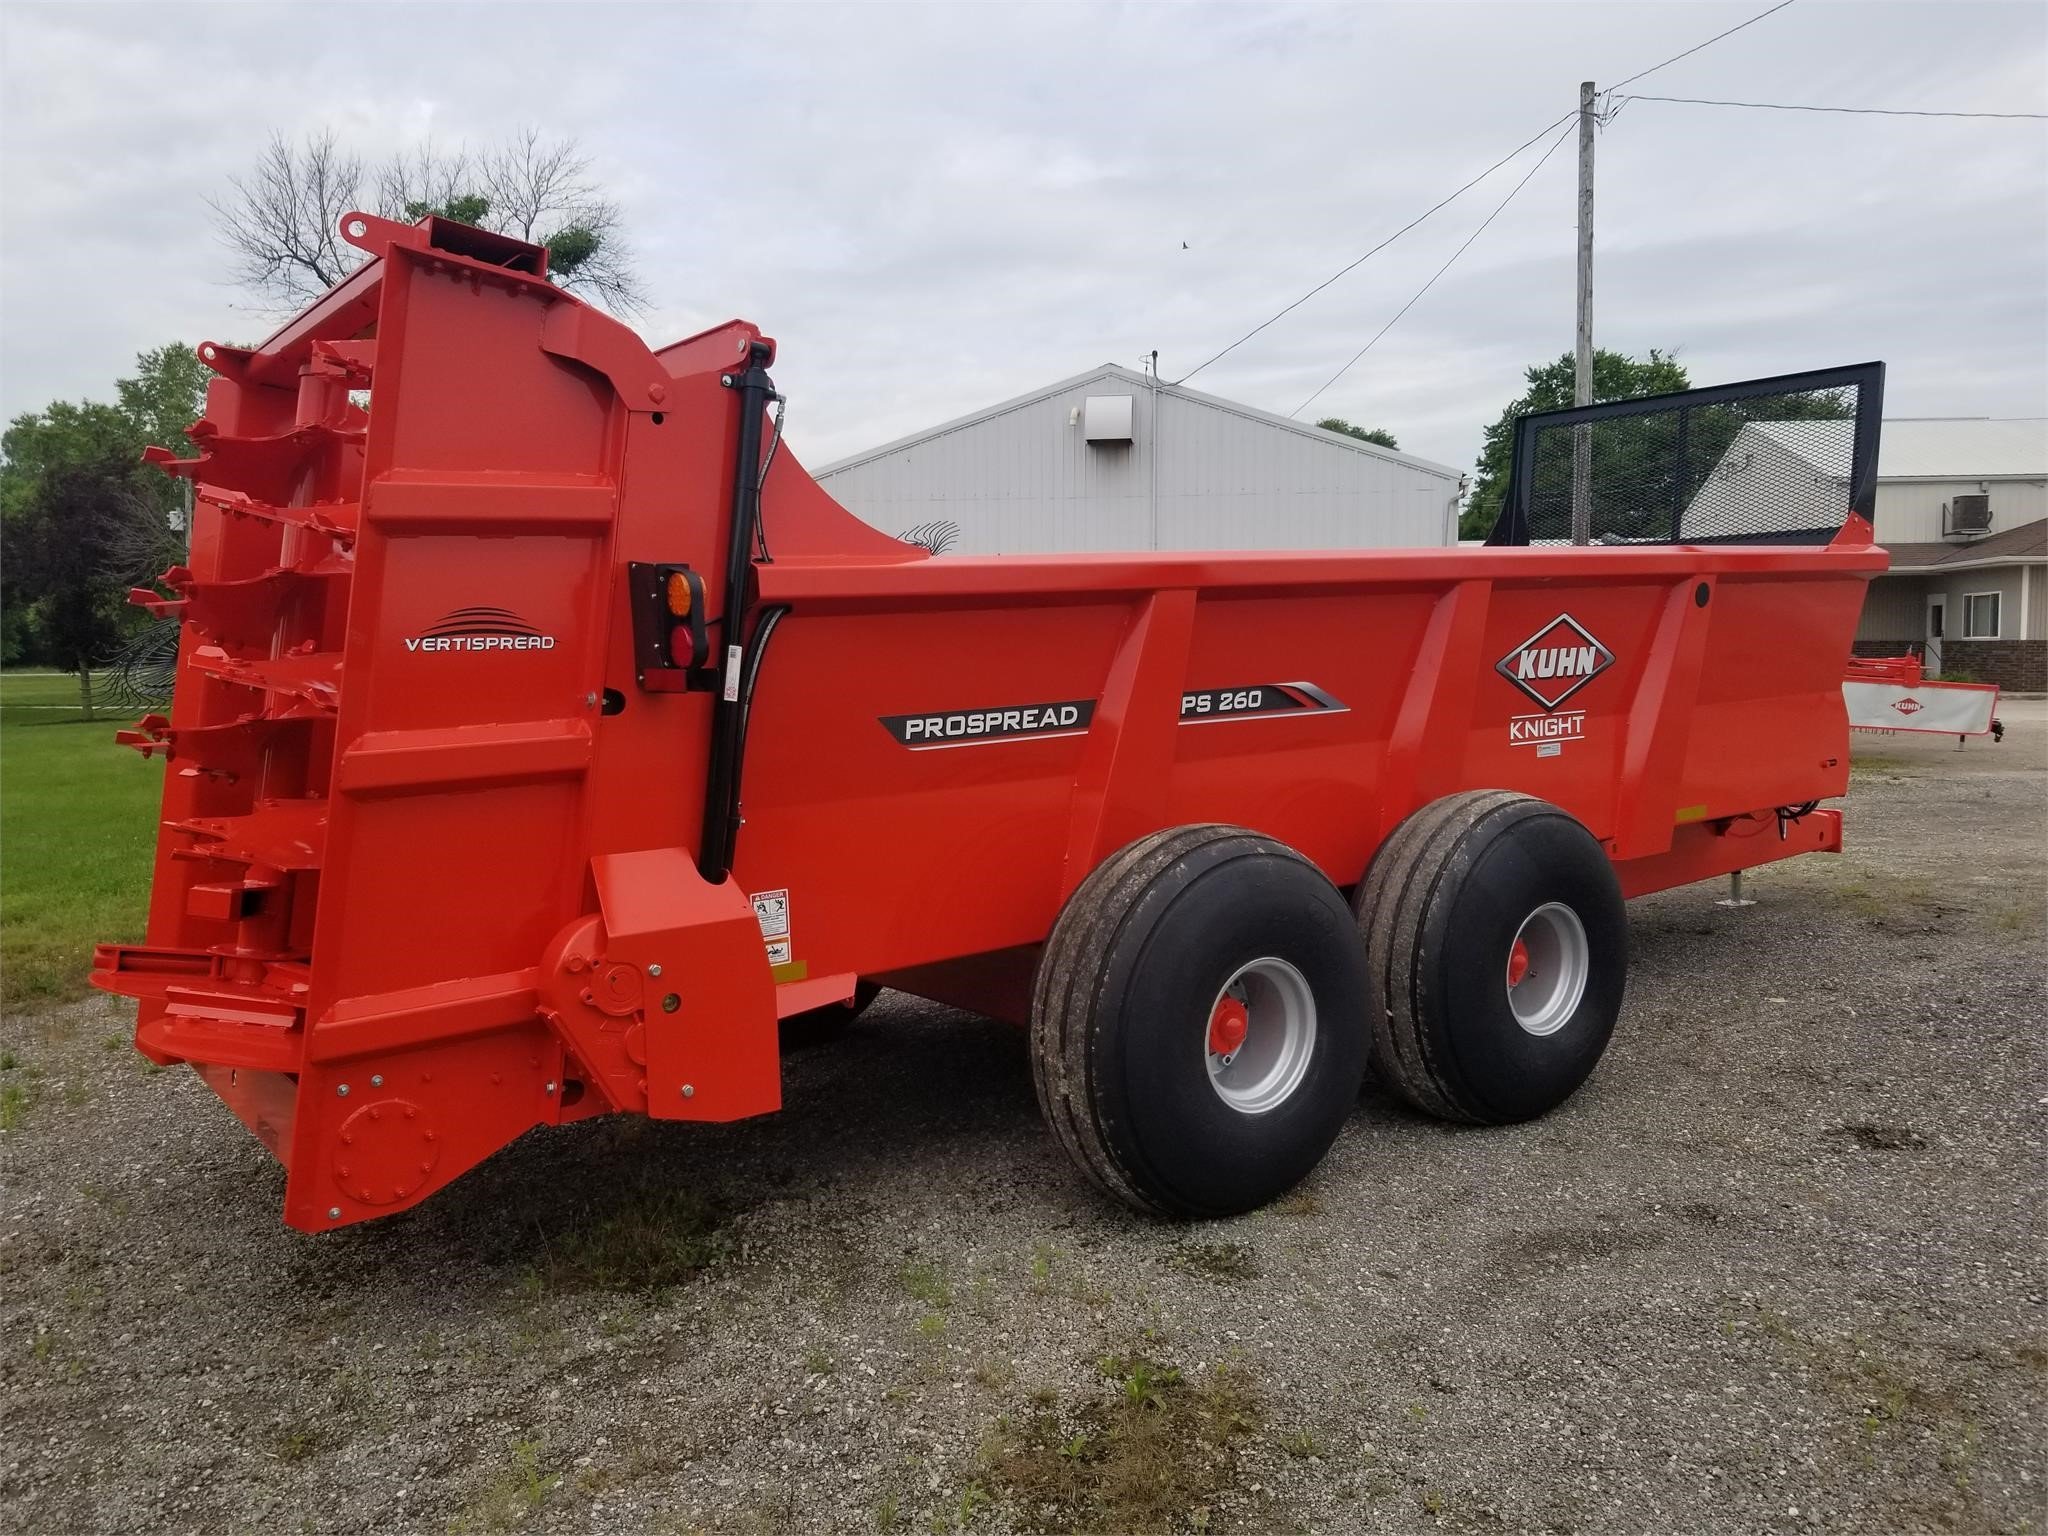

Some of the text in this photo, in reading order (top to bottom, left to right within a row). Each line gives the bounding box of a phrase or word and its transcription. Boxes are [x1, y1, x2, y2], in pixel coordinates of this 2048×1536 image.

[405, 636, 555, 652] VERTISPREAD
[1517, 646, 1597, 680] KUHN
[1181, 690, 1262, 715] PS 260
[1895, 702, 1920, 711] KUHN
[905, 706, 1078, 740] PROSPREAD
[1510, 715, 1585, 740] KNIGHT
